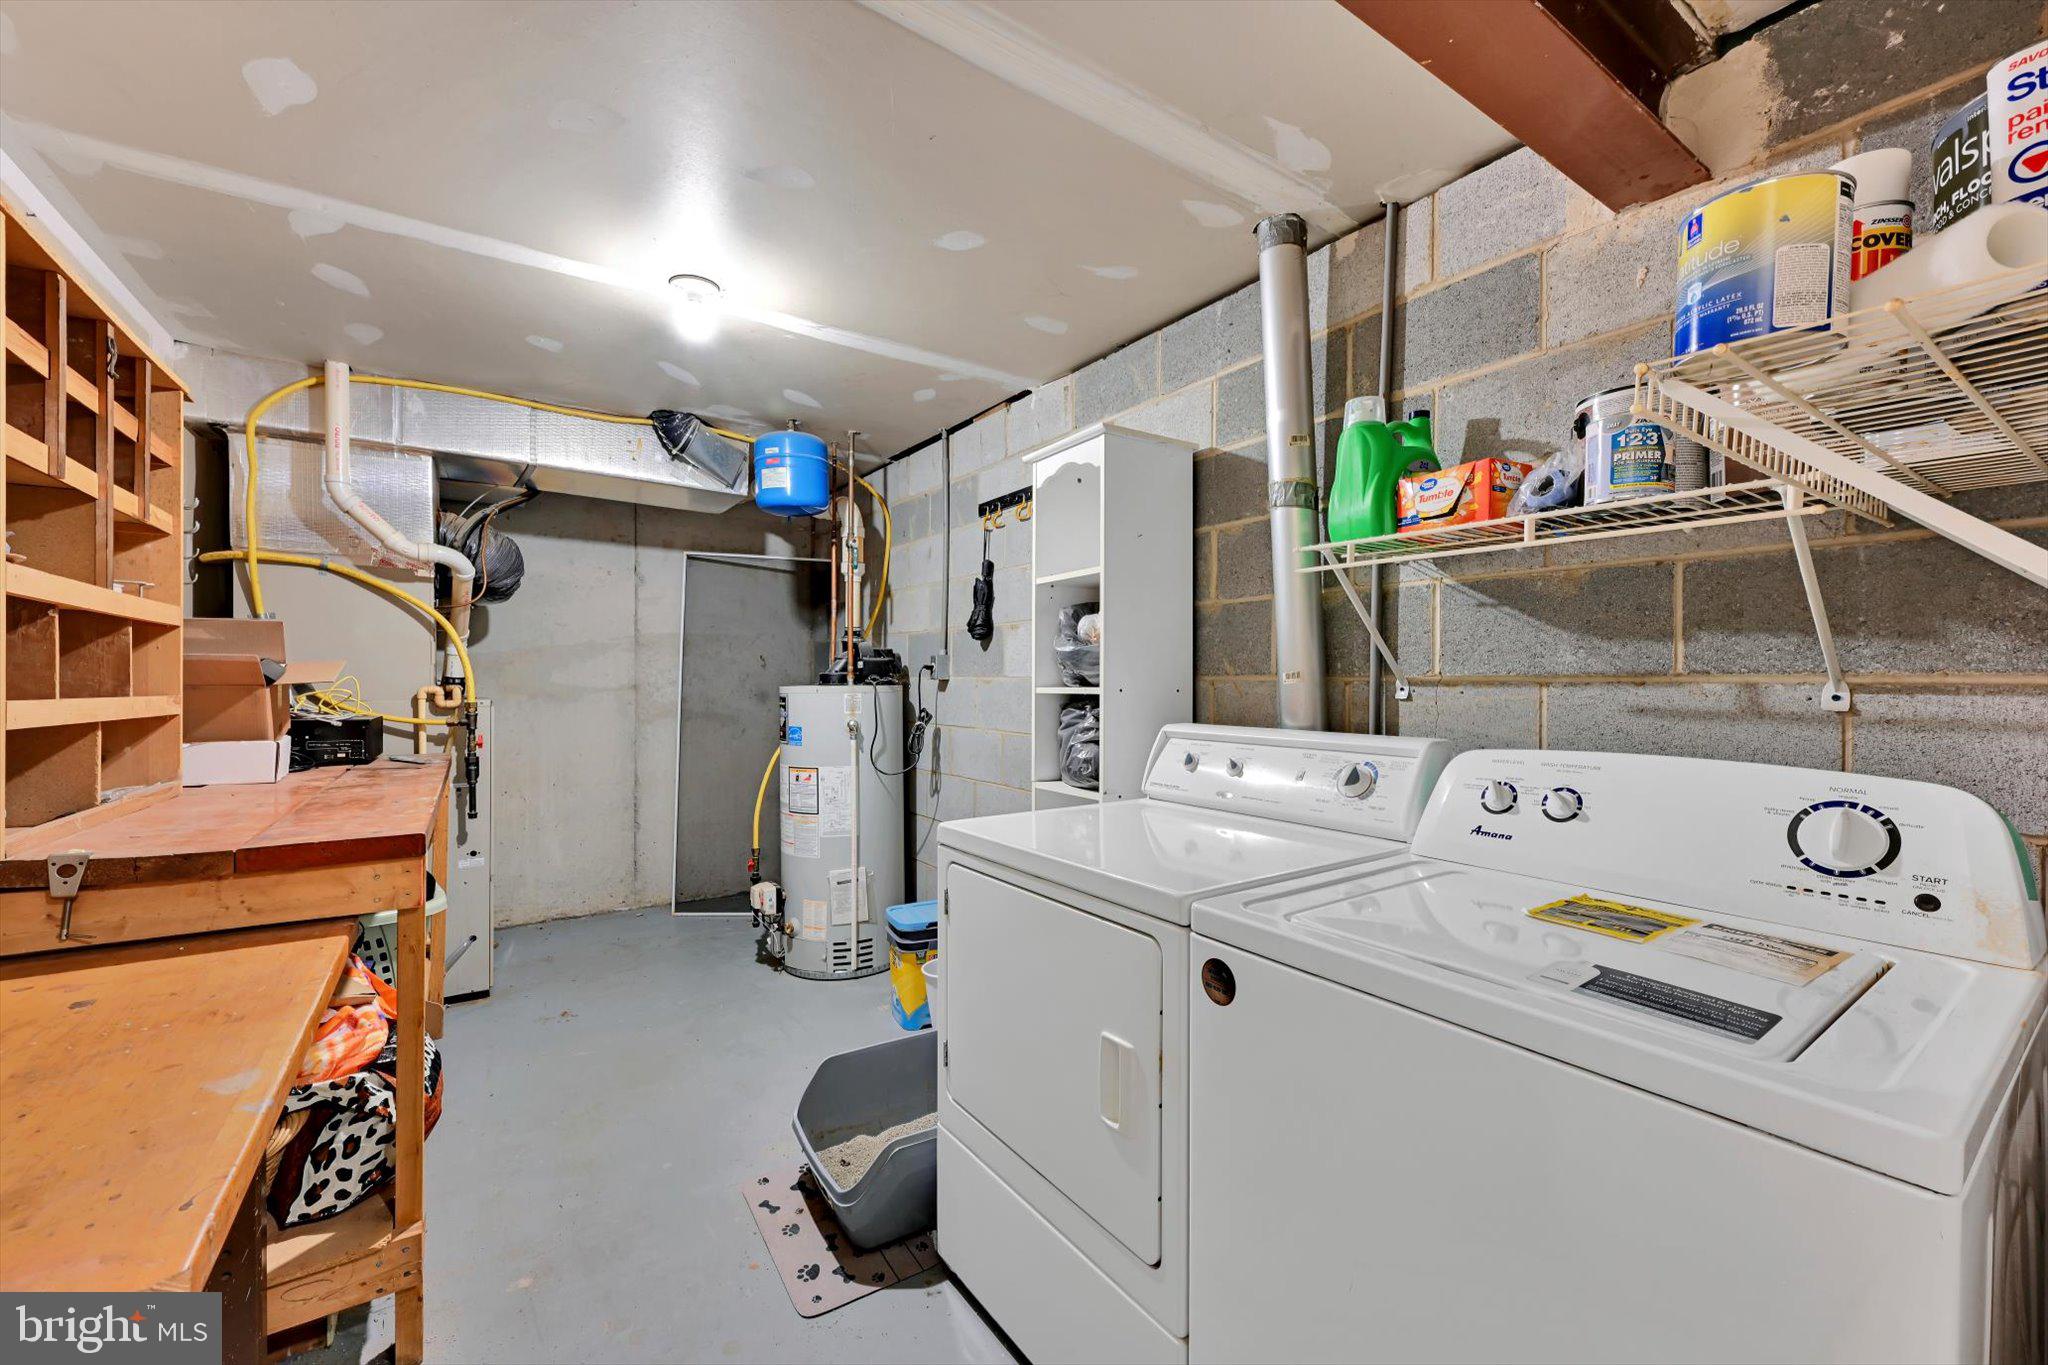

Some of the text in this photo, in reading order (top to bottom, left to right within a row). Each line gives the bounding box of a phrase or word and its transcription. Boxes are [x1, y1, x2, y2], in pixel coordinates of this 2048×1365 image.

[1870, 216, 1904, 226] ZINSSER
[1613, 449, 1662, 462] PRIMER
[1419, 488, 1454, 504] Tumble
[1829, 785, 1867, 797] NORMAL
[1470, 824, 1514, 841] Amana
[1911, 874, 1949, 886] START
[1901, 908, 1929, 918] CANCEL
